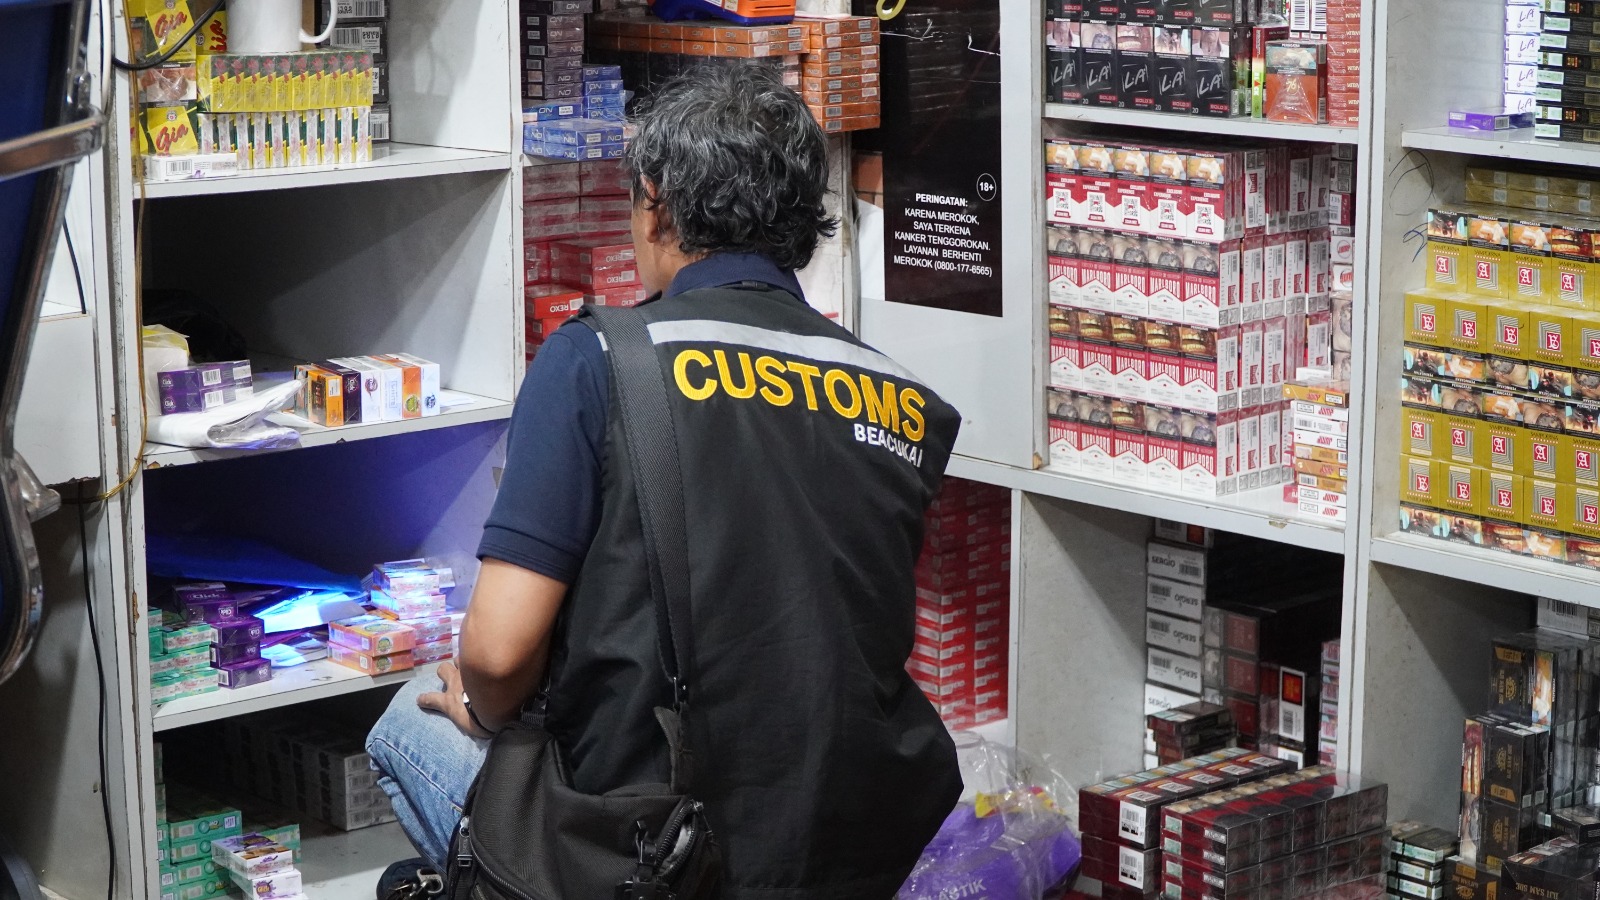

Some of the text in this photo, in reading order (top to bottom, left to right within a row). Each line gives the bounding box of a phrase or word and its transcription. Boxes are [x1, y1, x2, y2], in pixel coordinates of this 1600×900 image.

[980, 182, 994, 191] 18+
[916, 193, 968, 206] PERINGATAN:
[904, 208, 979, 224] KARENA MEROKOK,
[914, 221, 971, 236] SAYA TERKENA
[895, 231, 990, 250] KANKER TENGGOROKAN.
[904, 244, 982, 262] LAYANAN BERHENTI
[894, 255, 992, 277] MEROKOK (0800-177-6565)
[1050, 264, 1078, 287] MARLBORO
[1081, 268, 1111, 289] MARLBORO
[1116, 272, 1146, 294] MARLBORO
[1150, 277, 1180, 299] MARLBORO
[1185, 281, 1216, 303] MARLBORO
[550, 304, 569, 312] REXO
[1050, 344, 1079, 366] MARLBORO
[1082, 349, 1112, 371] MARLBORO
[1116, 355, 1145, 378] MARLBORO
[1150, 360, 1180, 382] MARLBORO
[1184, 366, 1215, 389] MARLBORO
[674, 350, 925, 442] CUSTOMS
[854, 423, 922, 468] BEACUKAI
[1050, 426, 1078, 448] MARLBORO
[1082, 432, 1111, 454] MARLBORO
[1115, 438, 1144, 461] MARLBORO
[1149, 444, 1178, 467] MARLBORO
[1183, 451, 1214, 474] MARLBORO
